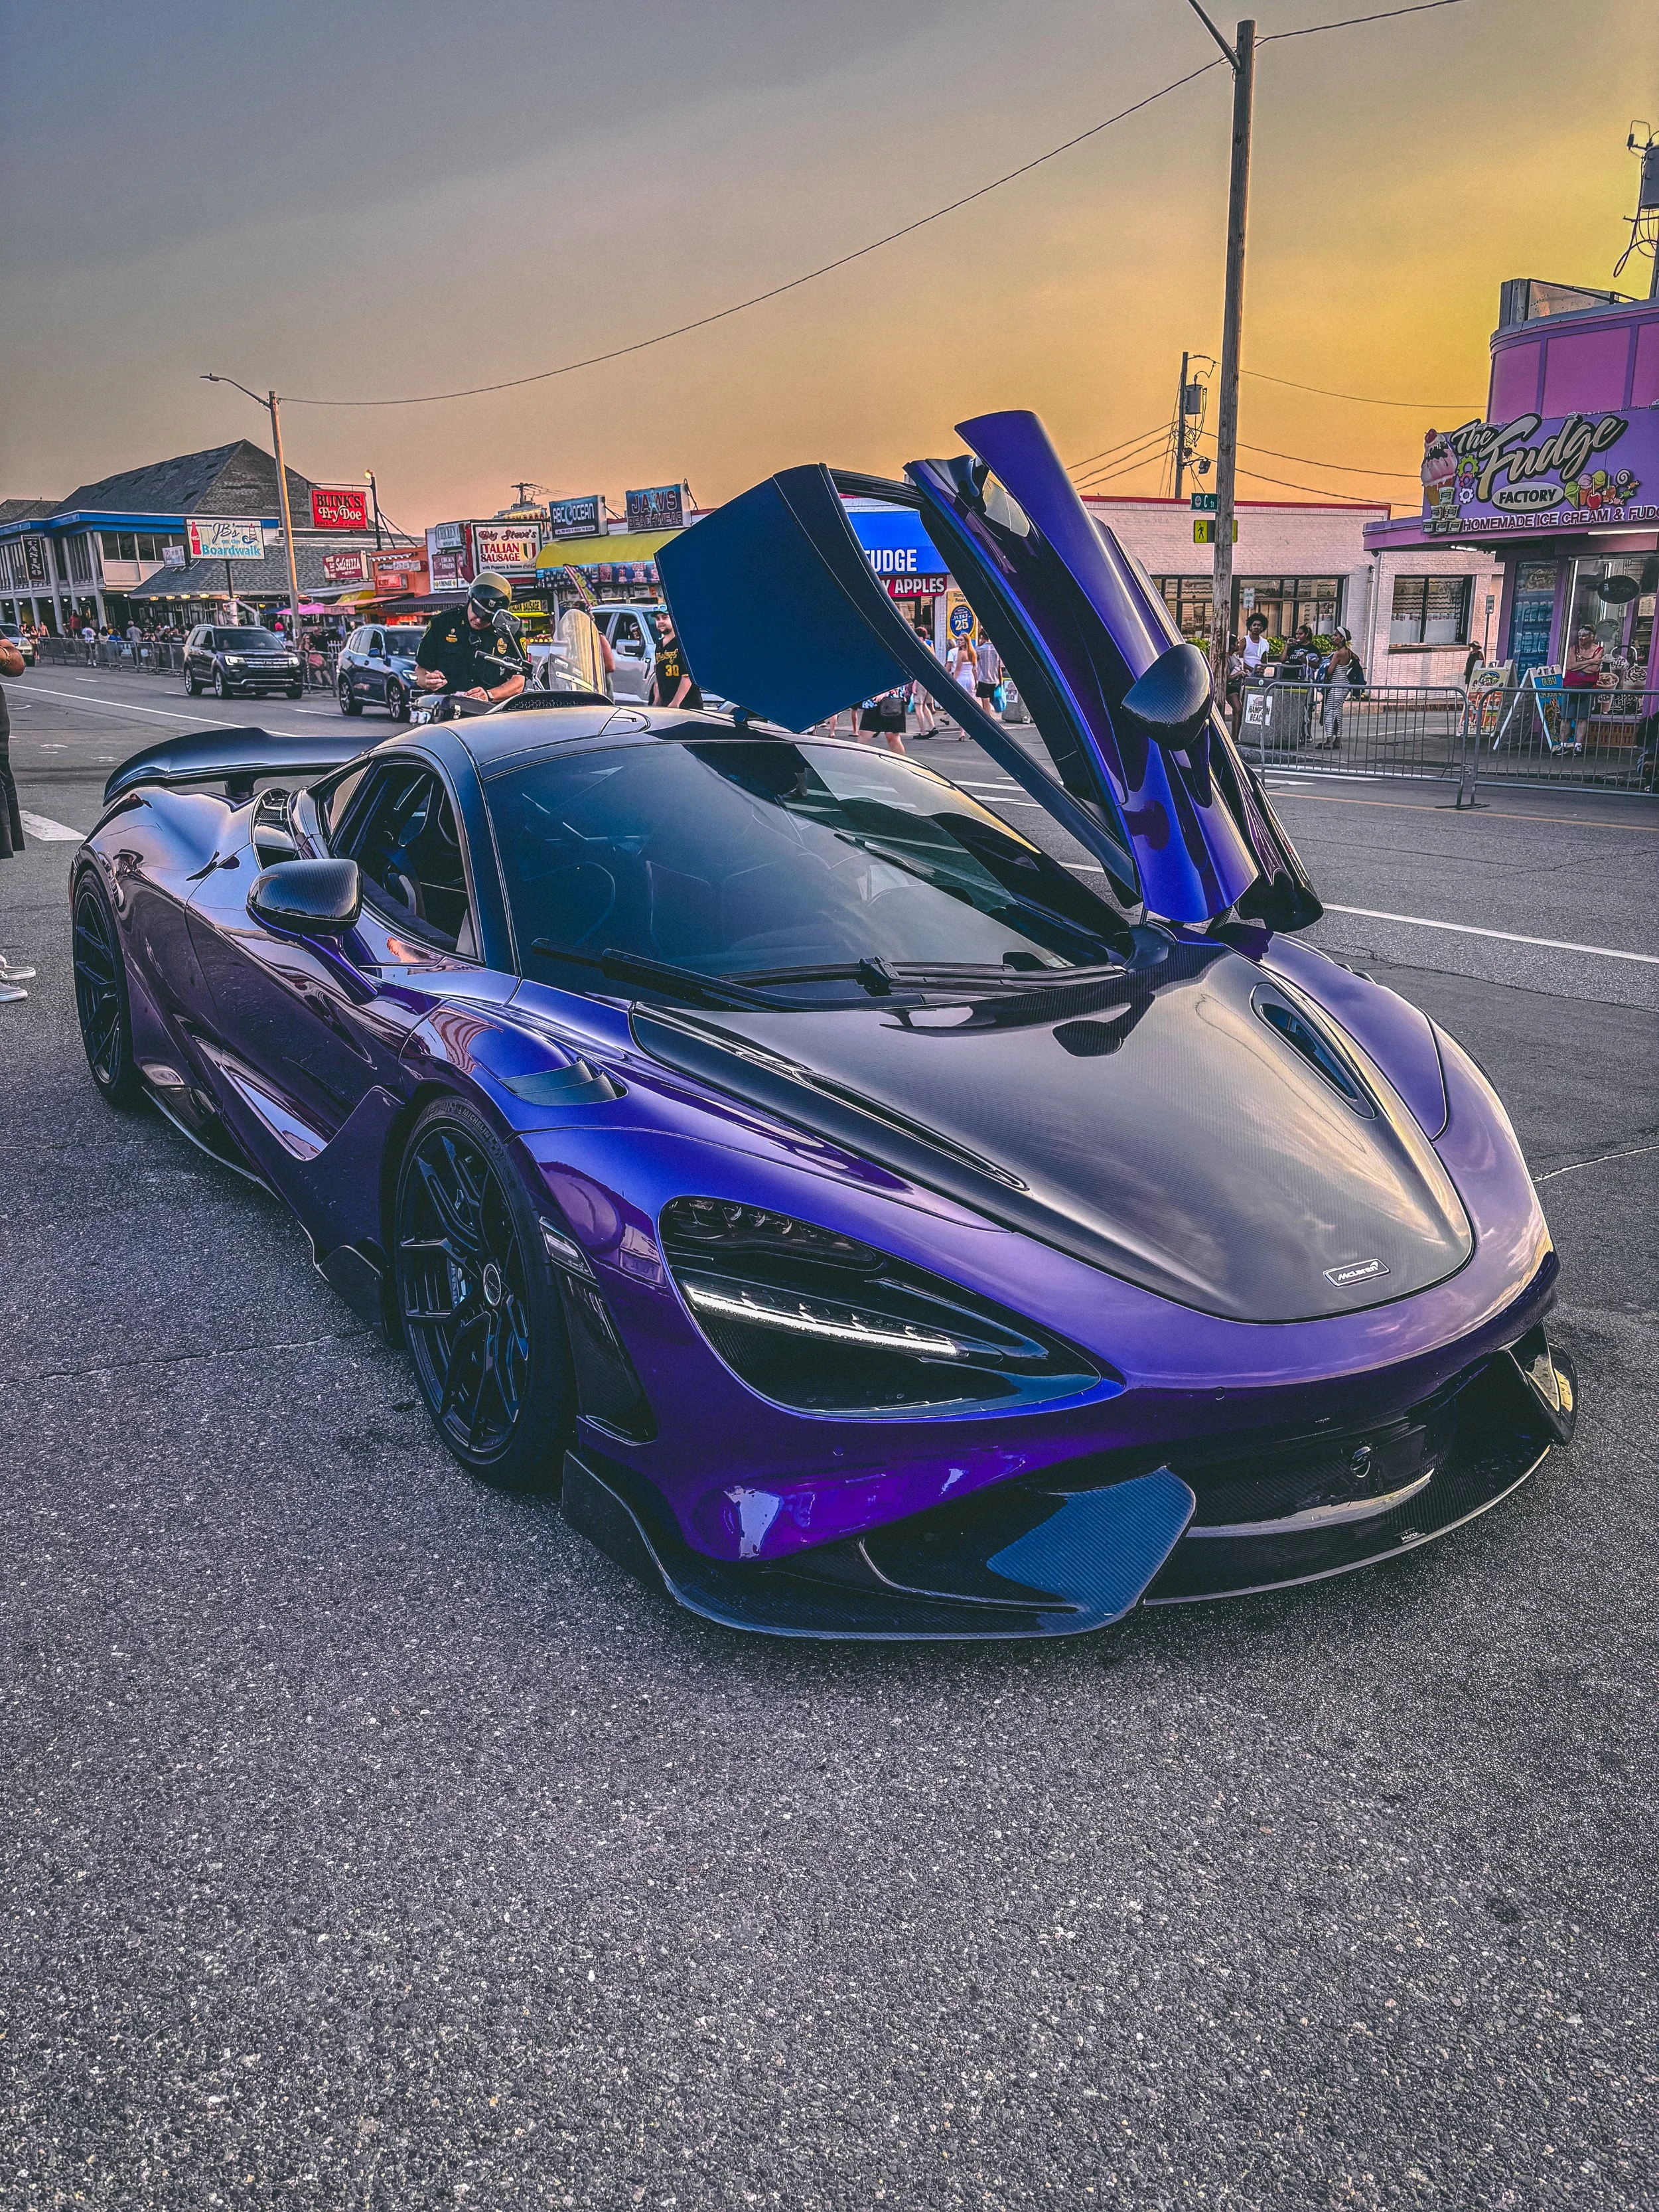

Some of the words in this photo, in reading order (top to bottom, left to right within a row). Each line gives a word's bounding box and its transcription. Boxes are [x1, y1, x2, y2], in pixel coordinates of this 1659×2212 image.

[1453, 419, 1497, 453] The
[1475, 414, 1626, 501] Fudge
[315, 494, 362, 509] BLINK'S
[1204, 494, 1208, 508] C
[1498, 488, 1557, 504] FACTORY
[318, 505, 346, 522] Fry
[339, 508, 362, 521] Doe
[553, 507, 565, 524] ABC
[572, 503, 595, 521] OCEAN
[1462, 514, 1535, 531] HOMEMADE
[1536, 512, 1559, 526] ICE
[1560, 508, 1610, 525] CREAM
[1613, 506, 1625, 522] &
[212, 523, 240, 544] JB's
[202, 544, 262, 557] Boardwalk
[480, 542, 520, 554] ITALIAN
[27, 540, 42, 575] CASINO
[345, 557, 361, 571] PIZZA
[480, 553, 521, 563] SAUSAGE
[894, 577, 945, 593] APPLES
[954, 619, 970, 631] 25
[665, 664, 680, 676] 30
[462, 1108, 492, 1139] MICHELIN
[1337, 1265, 1379, 1281] McLaren
